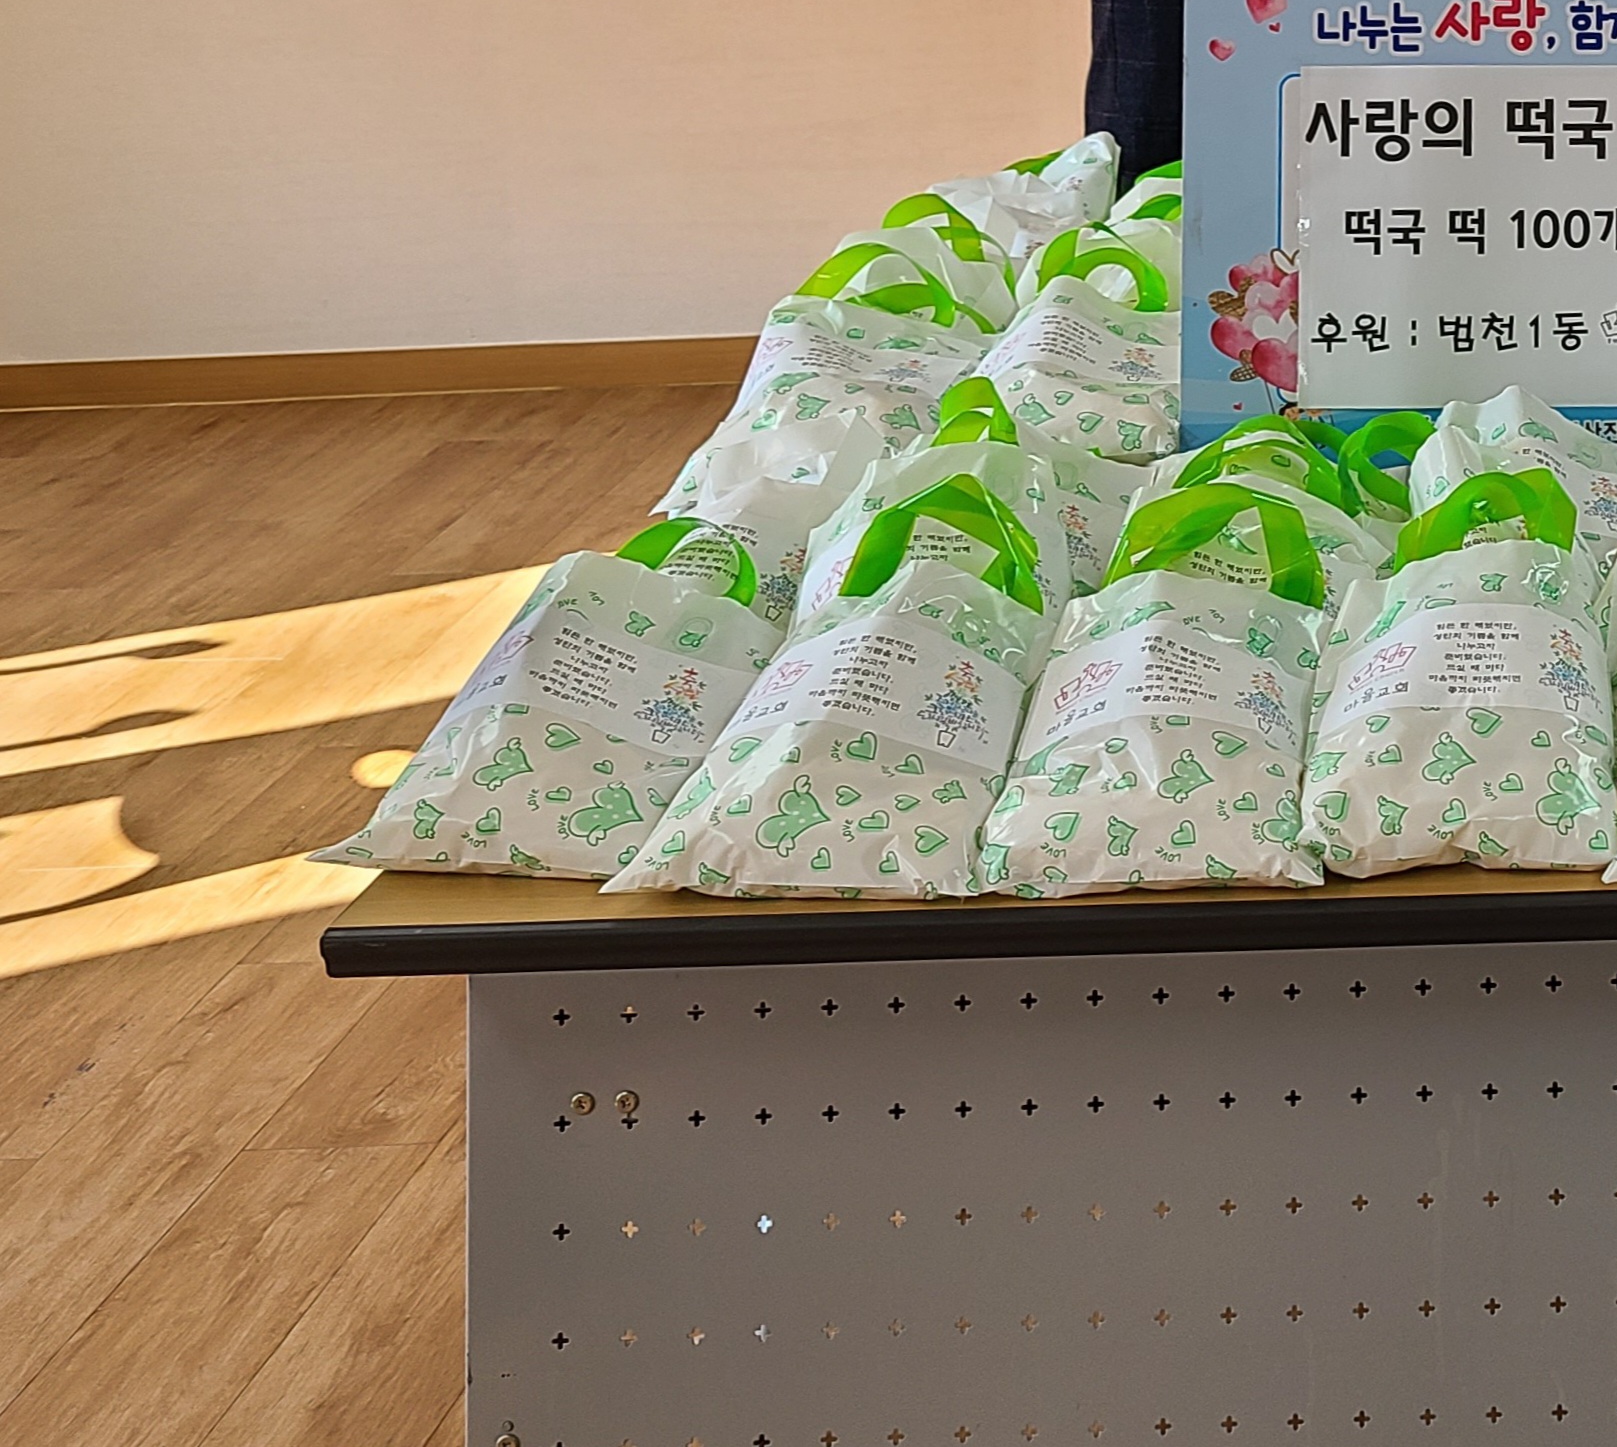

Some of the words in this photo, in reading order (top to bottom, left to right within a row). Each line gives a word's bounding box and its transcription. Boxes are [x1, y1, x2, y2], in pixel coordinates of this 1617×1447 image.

[1316, 4, 1422, 53] 나누는
[1305, 98, 1474, 159] 사랑의
[1505, 98, 1613, 159] 떡국
[1344, 208, 1425, 256] 떡국
[1447, 208, 1487, 256] 떡
[1311, 313, 1388, 352] 후원
[1343, 682, 1408, 713] 마을교회
[830, 739, 842, 762] LOVE
[527, 789, 540, 811] LOVE
[1482, 781, 1498, 801] LOVE
[1217, 799, 1230, 821] LOVE
[558, 814, 569, 839] LOVE
[842, 819, 854, 842] LOVE
[1251, 822, 1265, 845] LOVE
[1428, 824, 1454, 840] LOVE
[460, 831, 487, 848] LOVE
[1040, 842, 1066, 858] LOVE
[1155, 847, 1181, 863] LOVE
